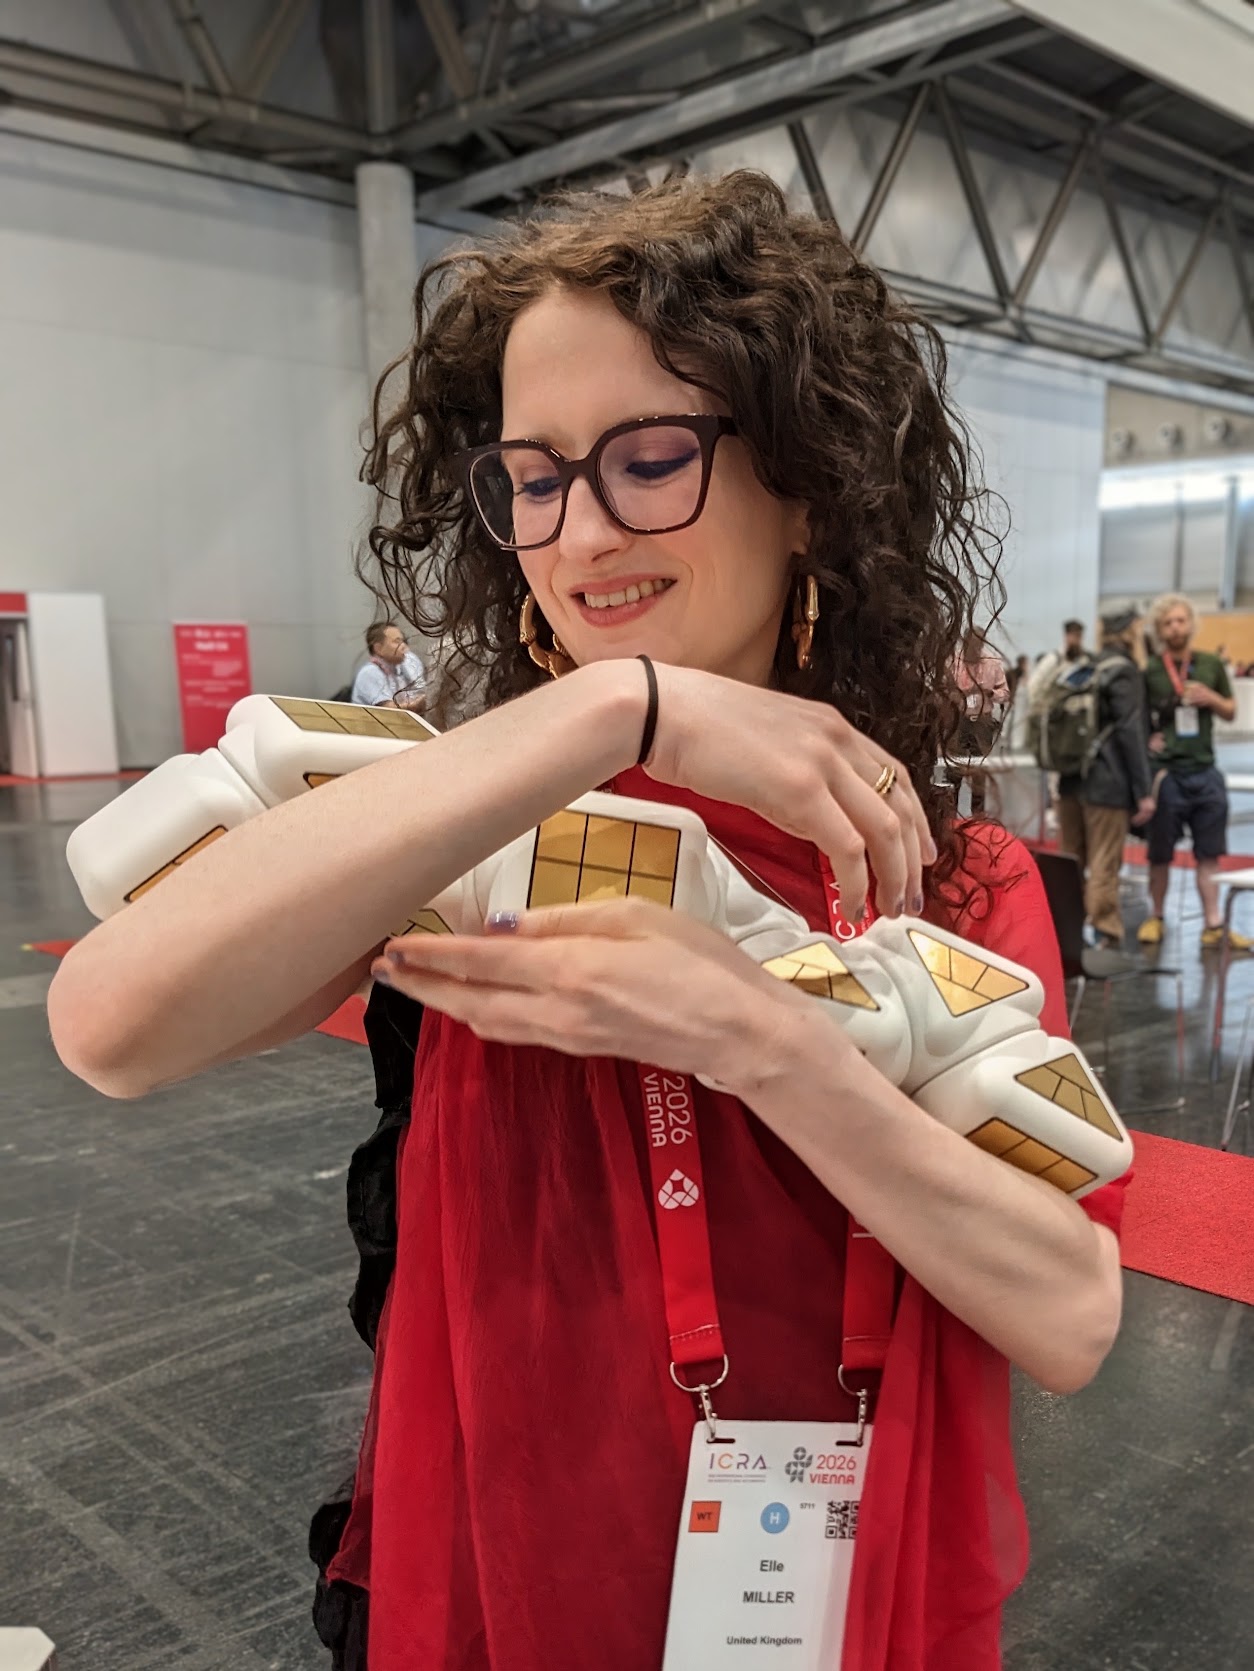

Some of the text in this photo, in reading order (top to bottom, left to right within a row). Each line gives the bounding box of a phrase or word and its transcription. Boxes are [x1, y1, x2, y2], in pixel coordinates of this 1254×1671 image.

[643, 1072, 668, 1148] VIENNA
[662, 1075, 693, 1145] 2026
[709, 1452, 767, 1470] ICRA
[816, 1454, 857, 1470] 2026
[809, 1473, 855, 1485] VIENNA
[697, 1511, 713, 1521] WT
[769, 1512, 780, 1525] H
[759, 1559, 785, 1573] Elle
[742, 1590, 795, 1604] MILLER
[726, 1635, 803, 1648] United Kingdom
